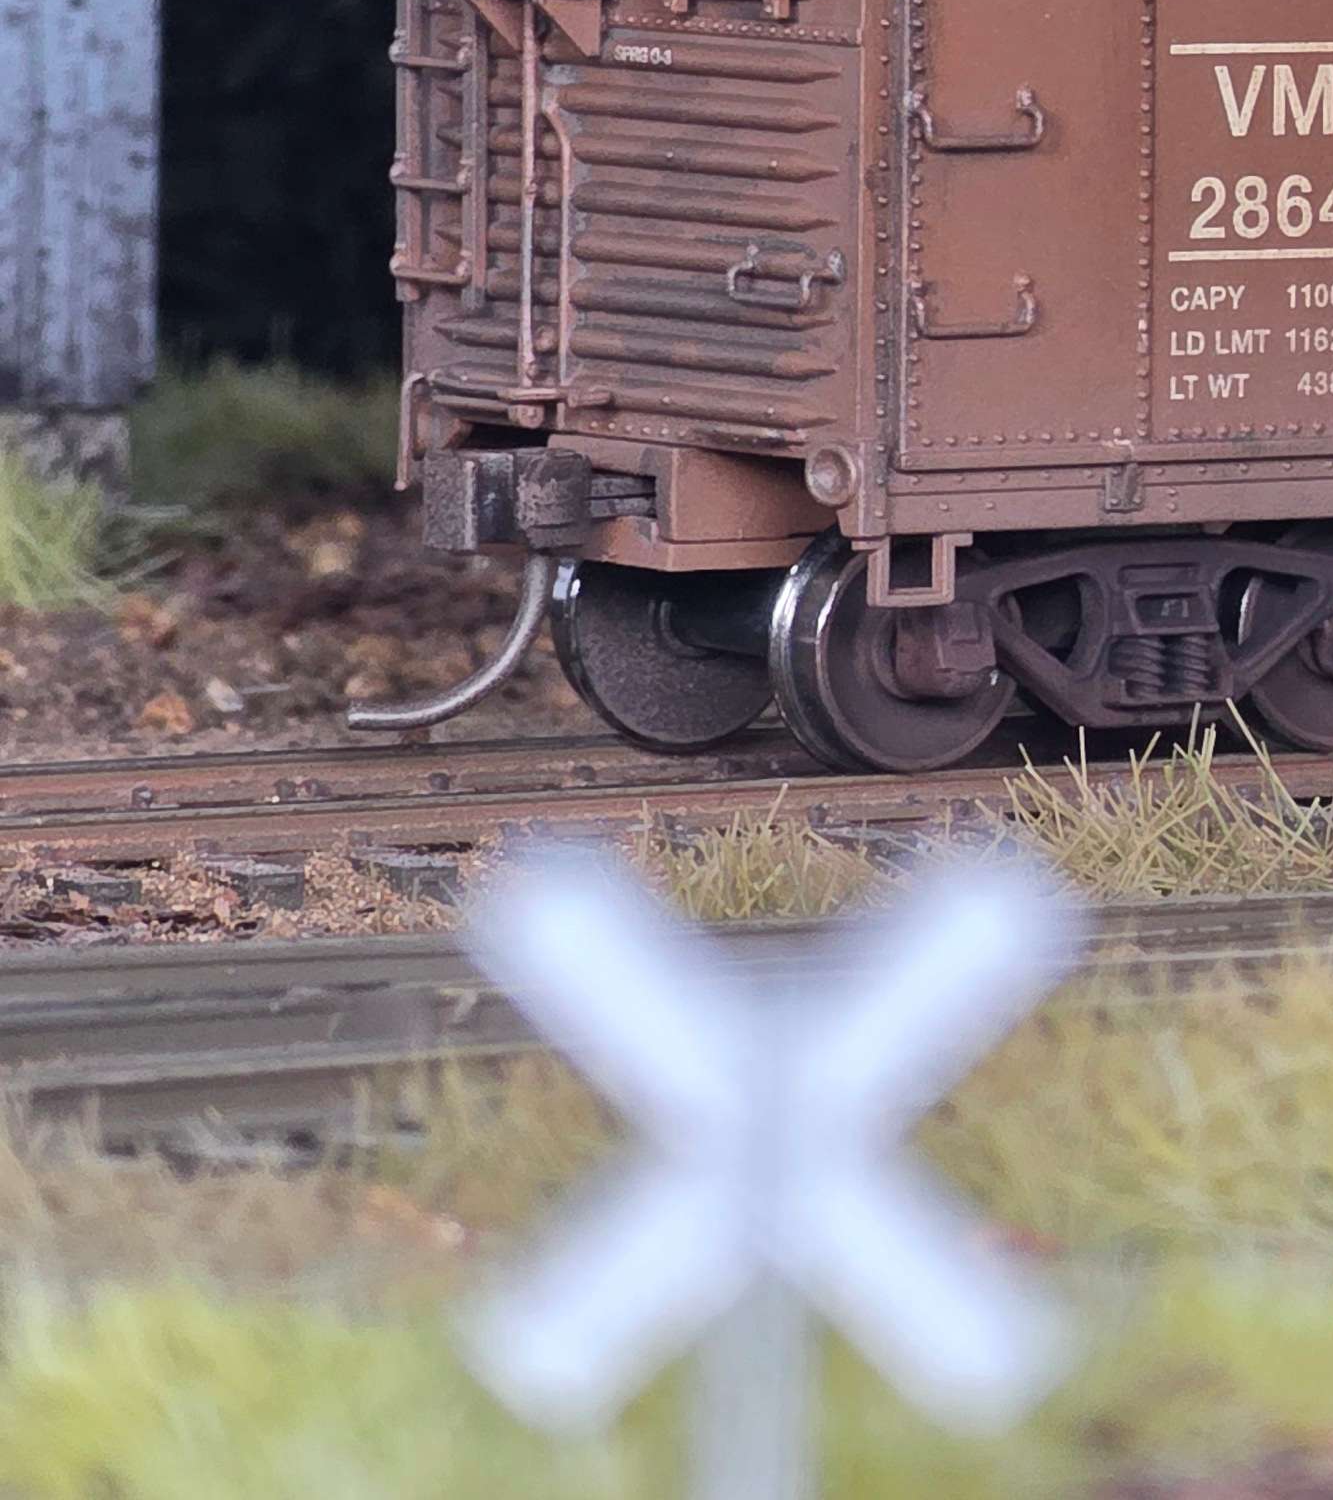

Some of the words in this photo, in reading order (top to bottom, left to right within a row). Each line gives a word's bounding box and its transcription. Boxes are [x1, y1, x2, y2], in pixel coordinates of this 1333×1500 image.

[1170, 285, 1245, 312] CAPY
[1170, 329, 1205, 356] LD
[1214, 329, 1271, 354] LMT
[1169, 374, 1199, 400] LT
[1207, 373, 1250, 399] WT
